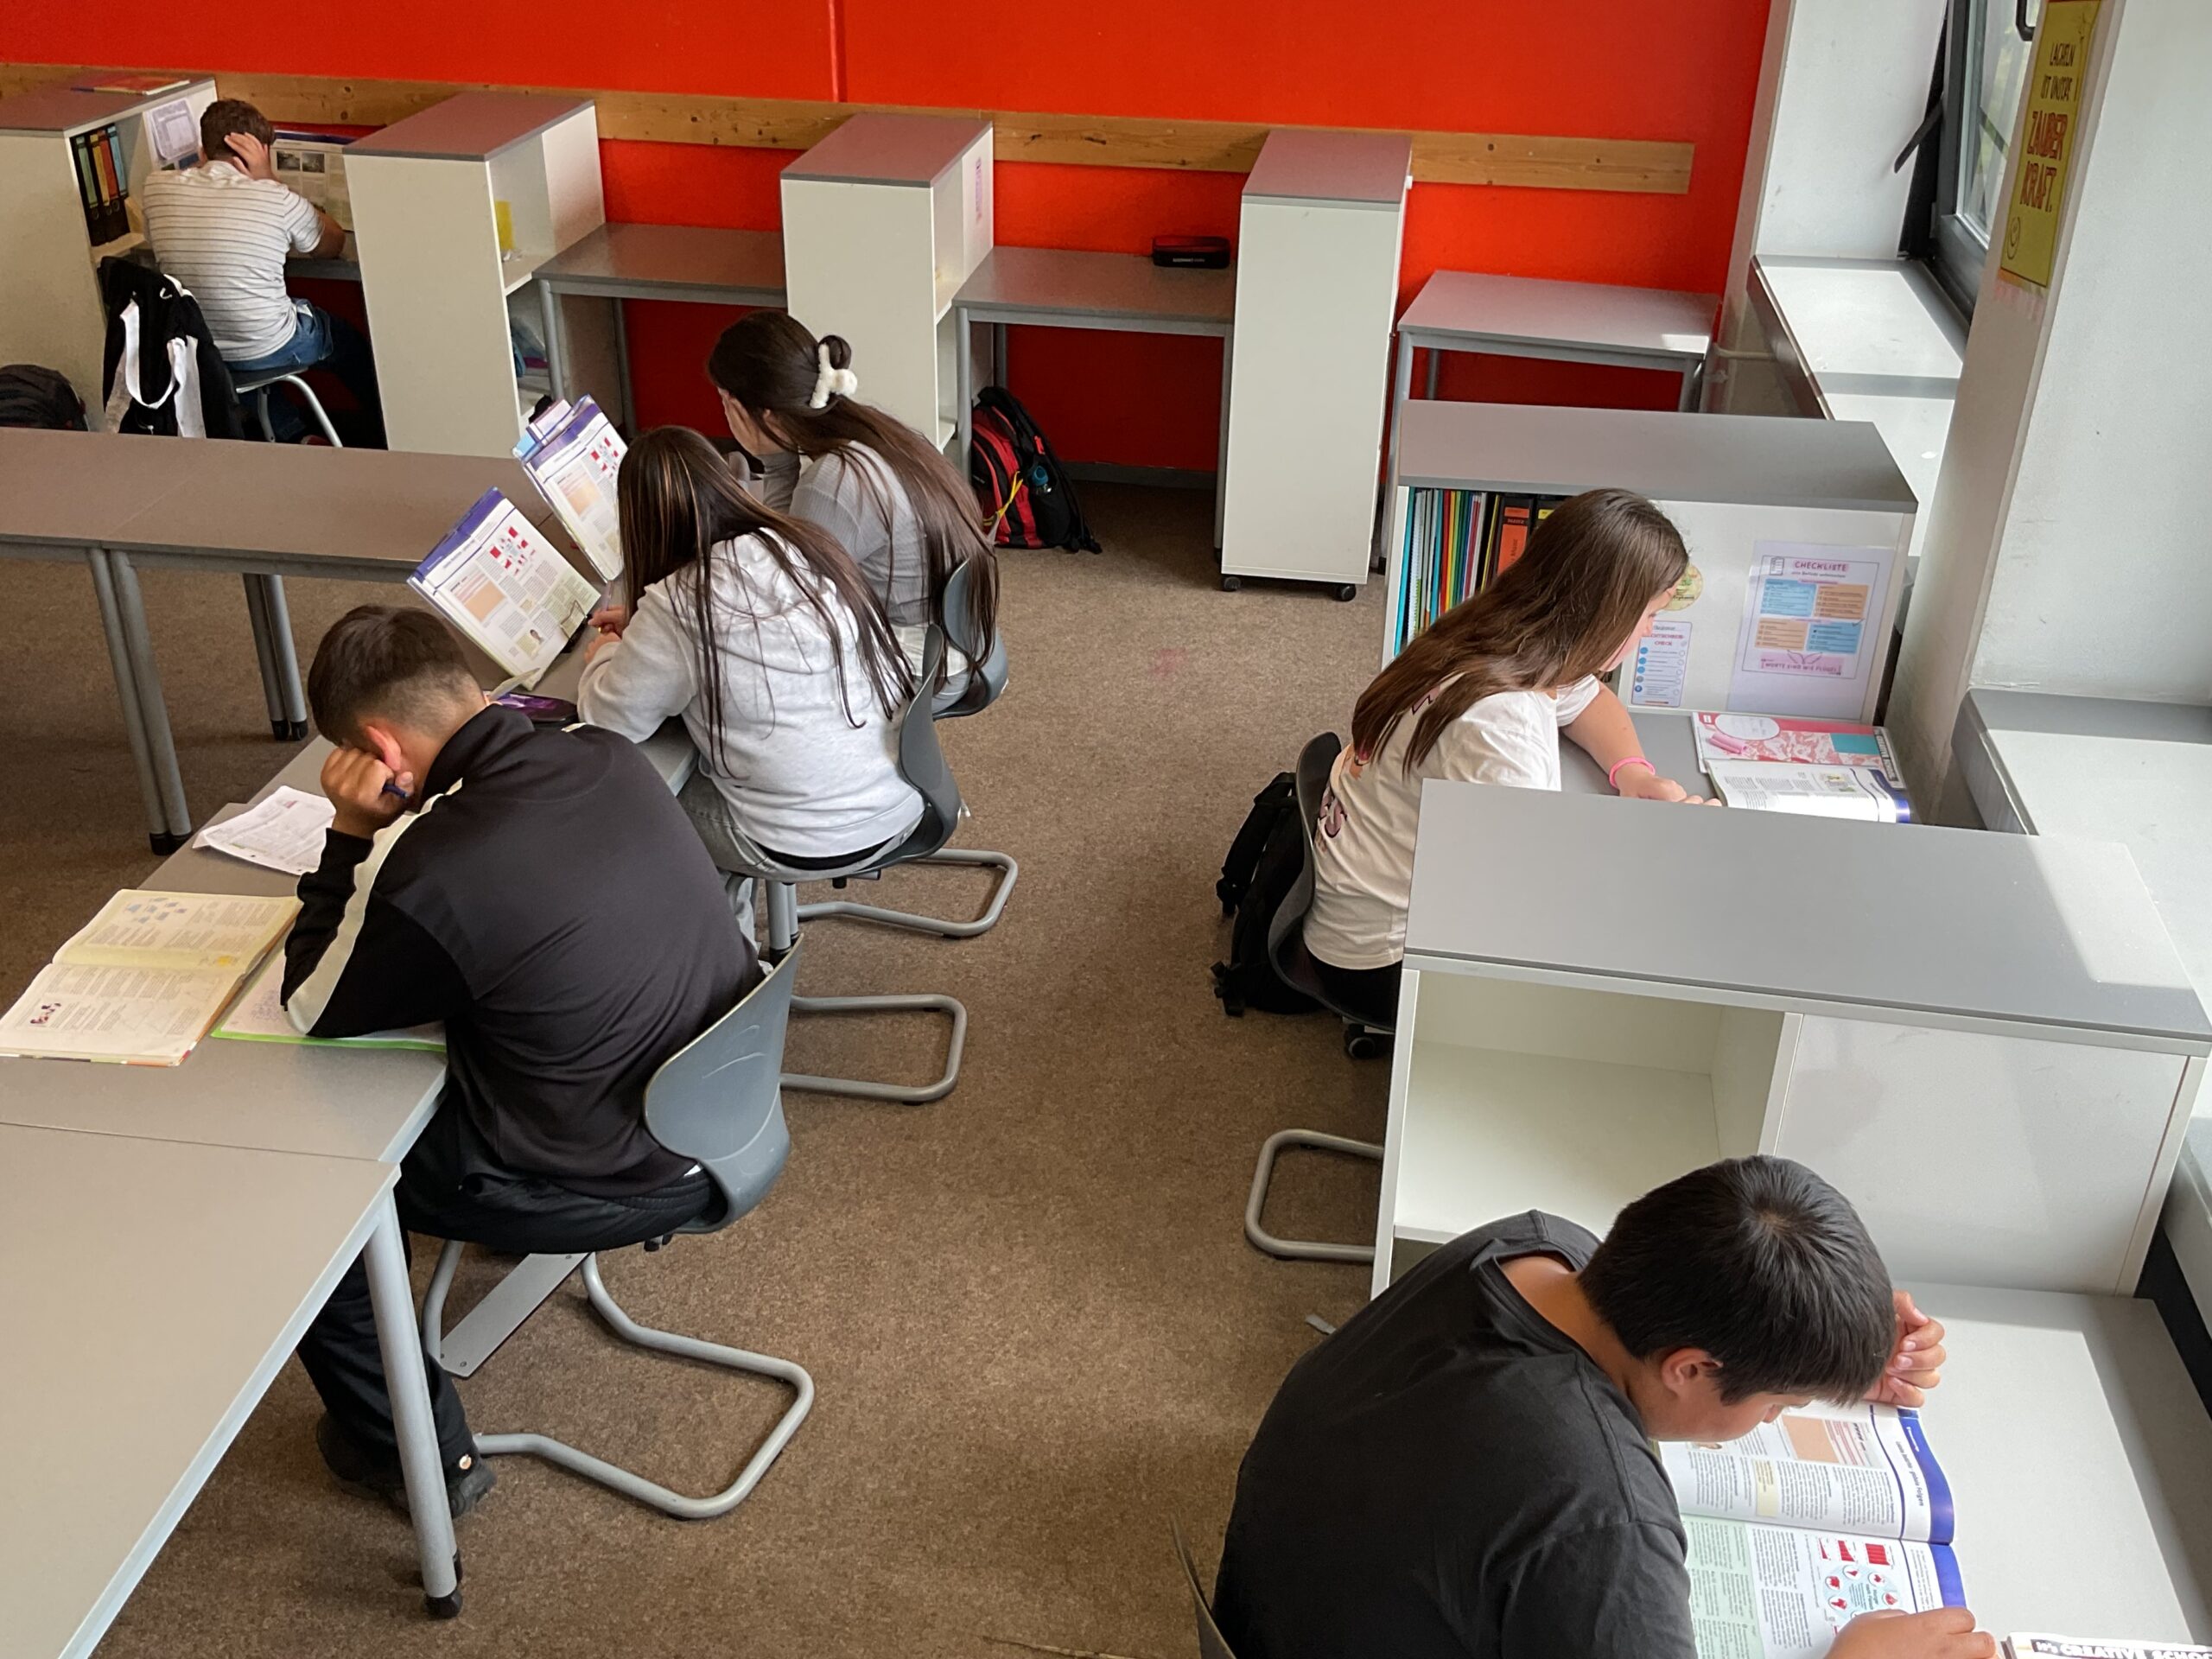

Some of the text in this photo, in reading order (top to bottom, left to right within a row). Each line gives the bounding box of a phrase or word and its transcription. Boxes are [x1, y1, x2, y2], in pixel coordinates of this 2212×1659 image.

[2026, 110, 2069, 162] ZAUBER
[1794, 560, 1847, 572] CHECKLISTE
[1916, 1487, 1924, 1506] Folgen
[2060, 1643, 2145, 1659] CREATIVE
